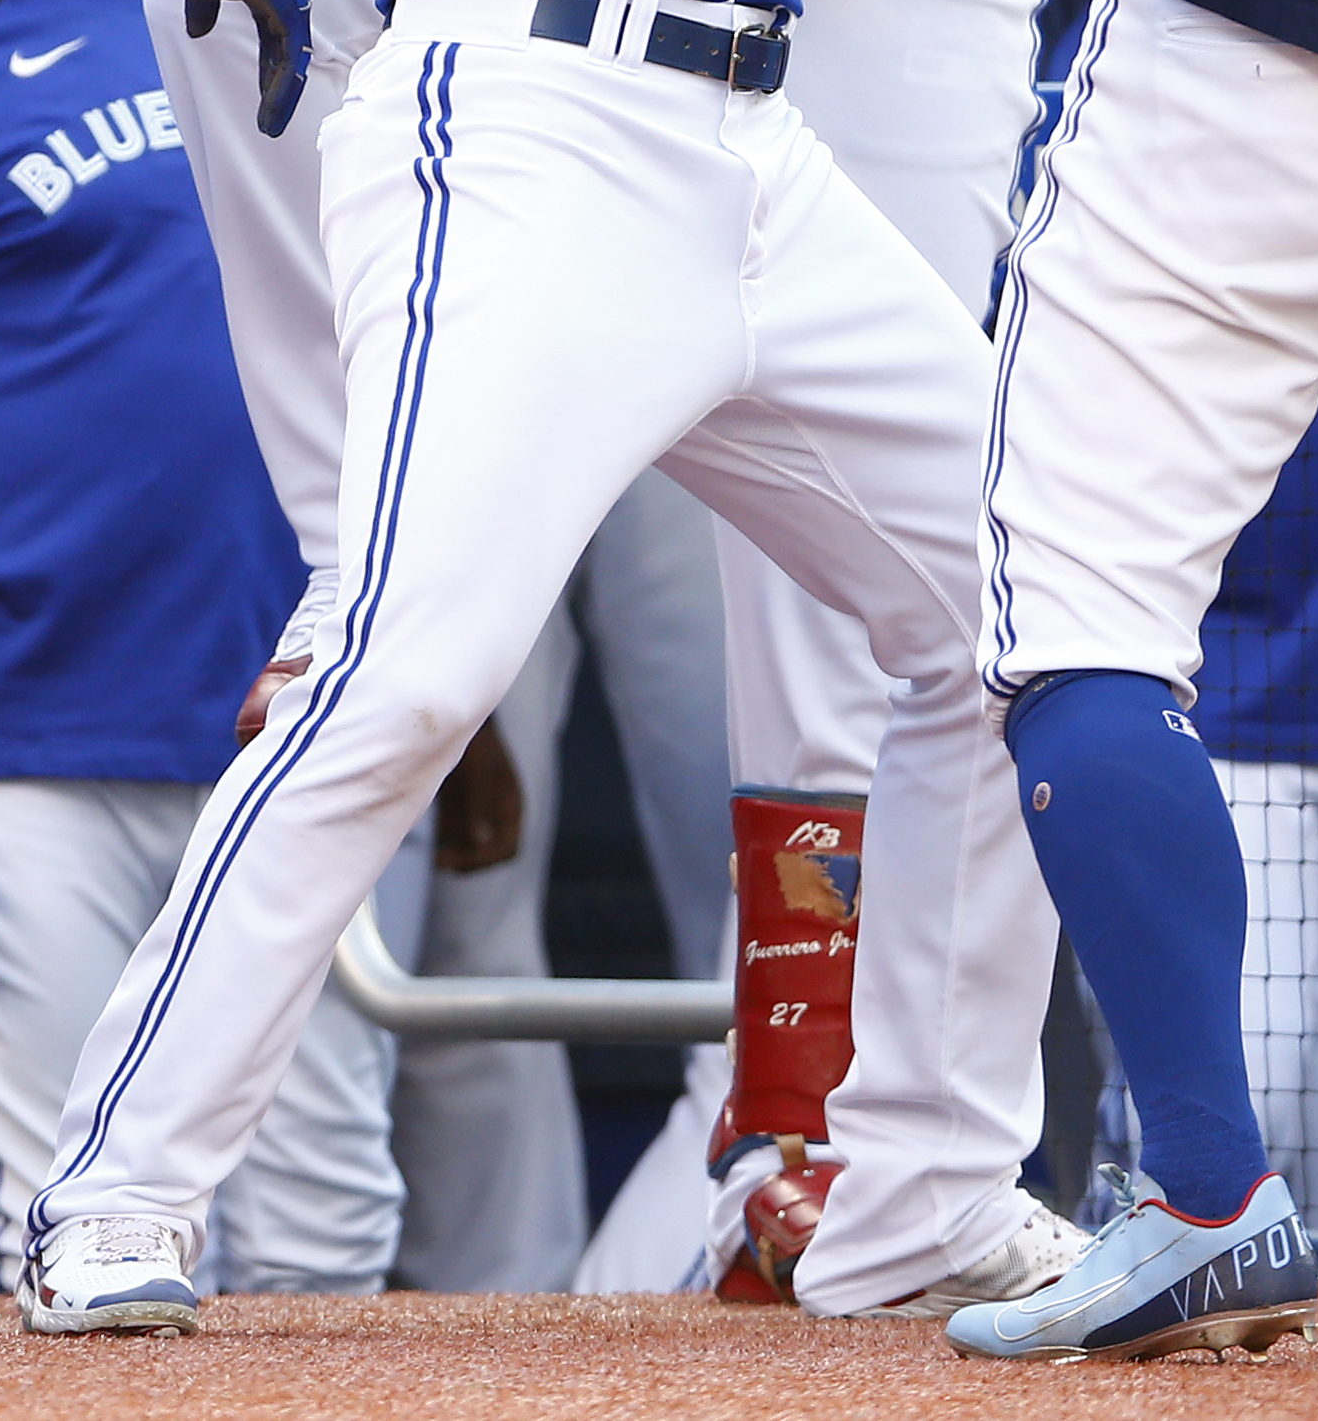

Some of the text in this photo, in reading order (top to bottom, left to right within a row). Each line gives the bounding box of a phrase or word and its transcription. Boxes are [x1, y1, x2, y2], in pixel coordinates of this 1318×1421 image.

[7, 88, 184, 217] BLUE
[745, 939, 823, 967] Guerrero
[768, 1001, 810, 1027] 27
